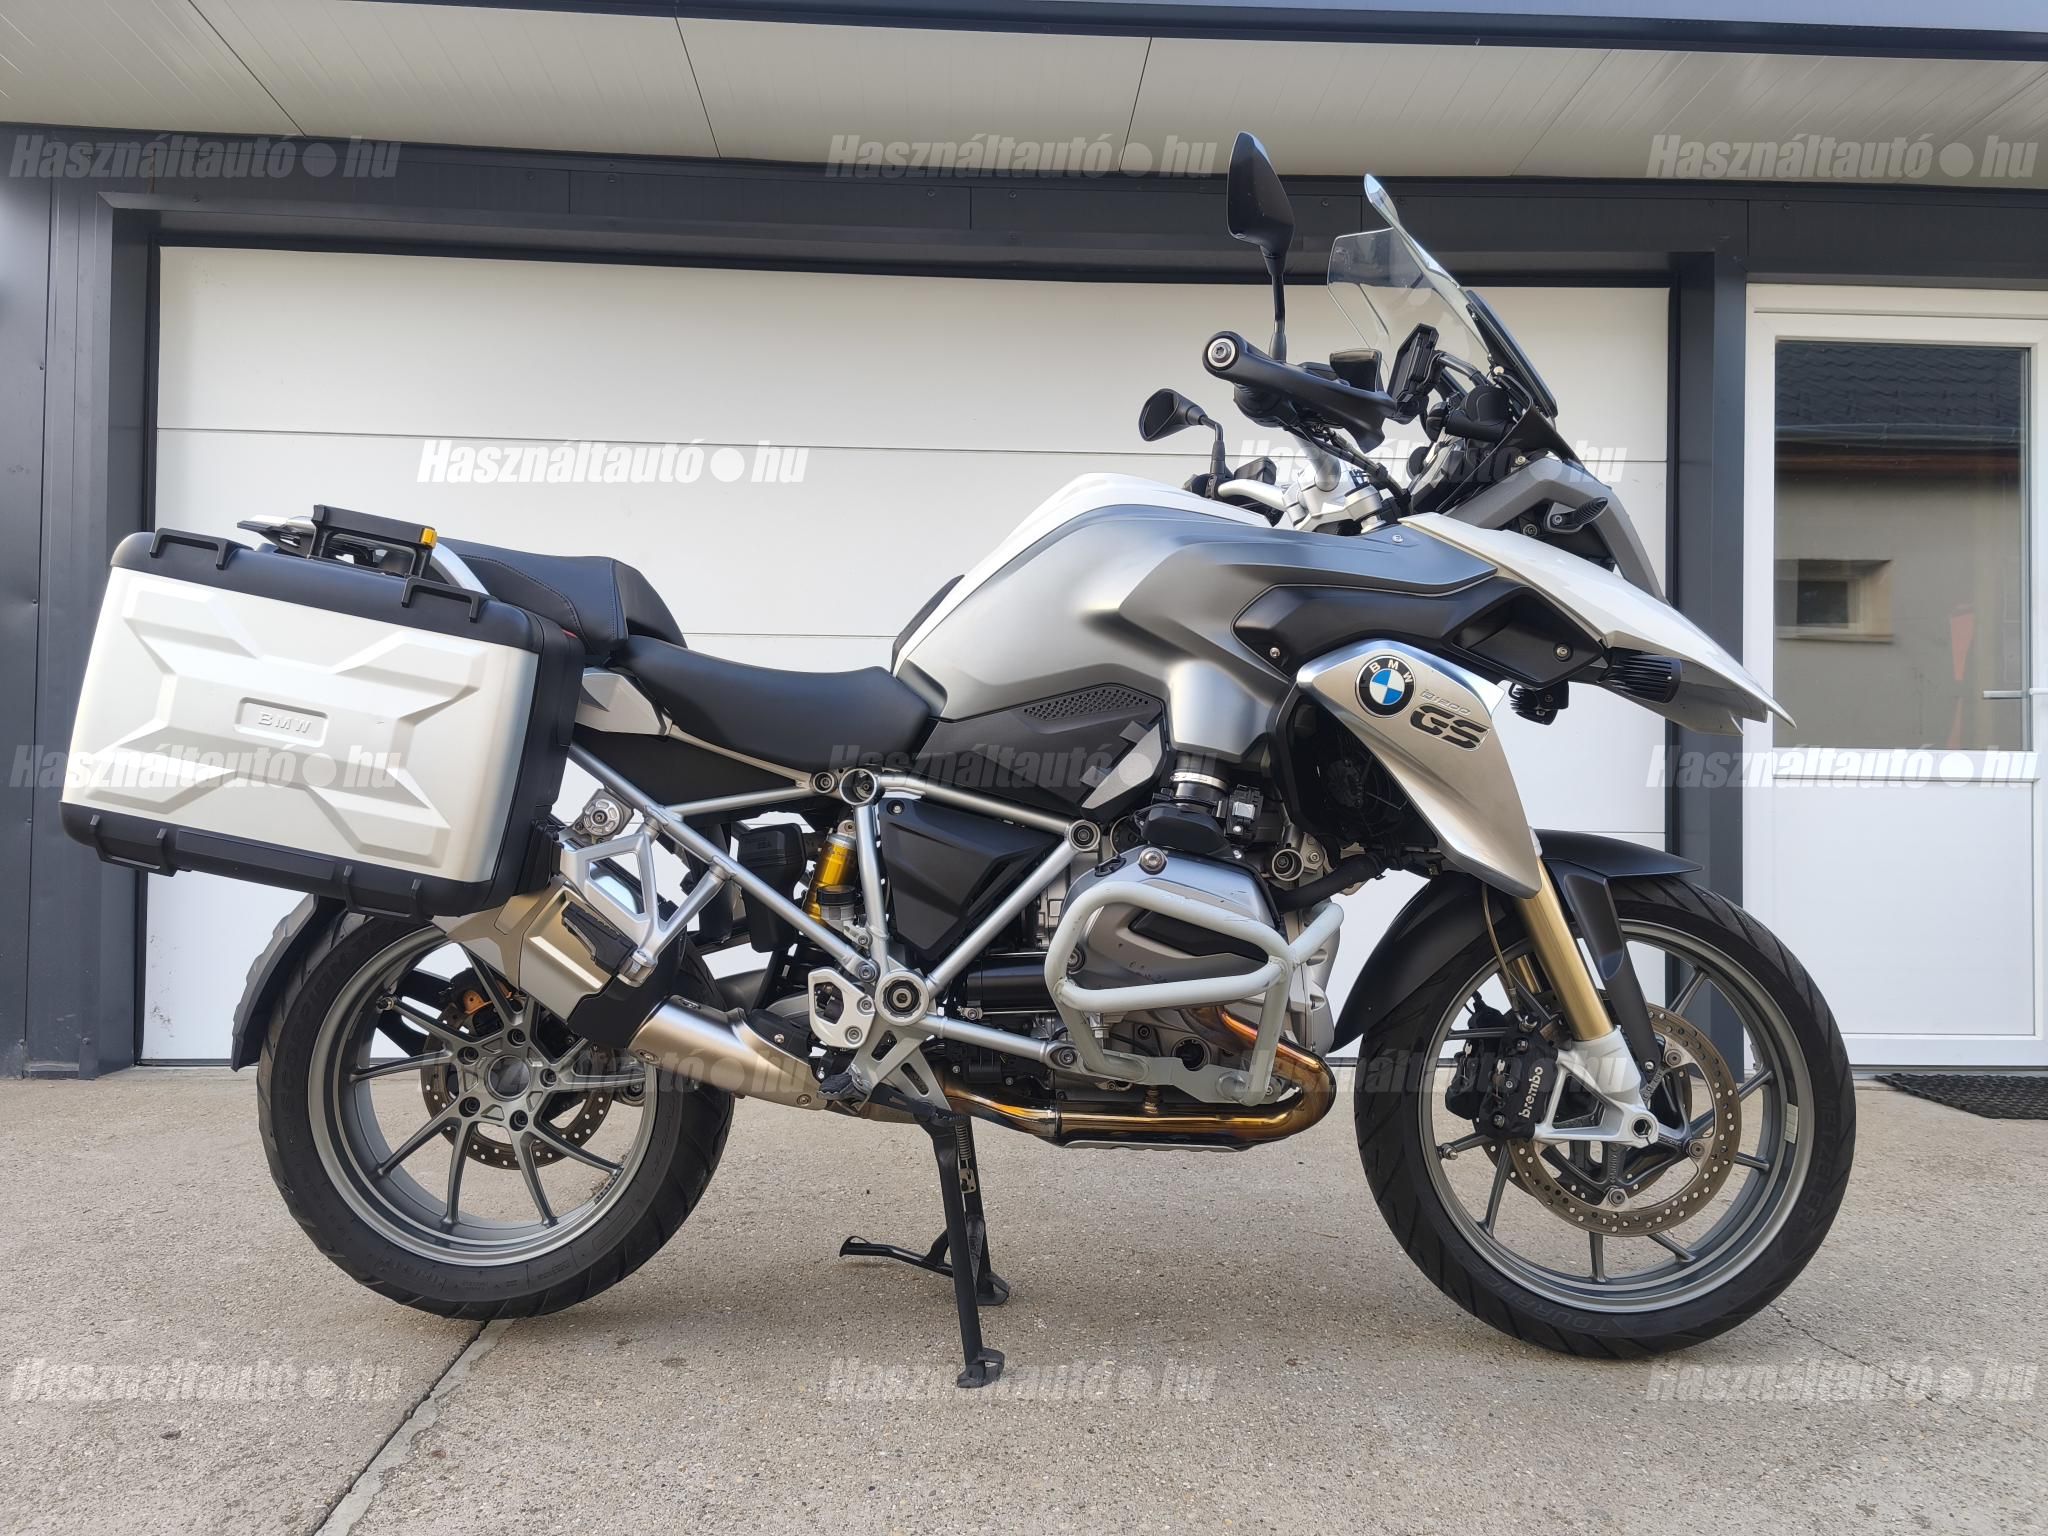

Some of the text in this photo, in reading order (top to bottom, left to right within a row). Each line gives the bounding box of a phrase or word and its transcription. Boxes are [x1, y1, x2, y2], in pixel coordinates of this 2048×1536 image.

[1369, 660, 1414, 683] BMW
[258, 711, 312, 734] BMW
[1411, 705, 1488, 749] GS
[1518, 1066, 1543, 1118] brembo
